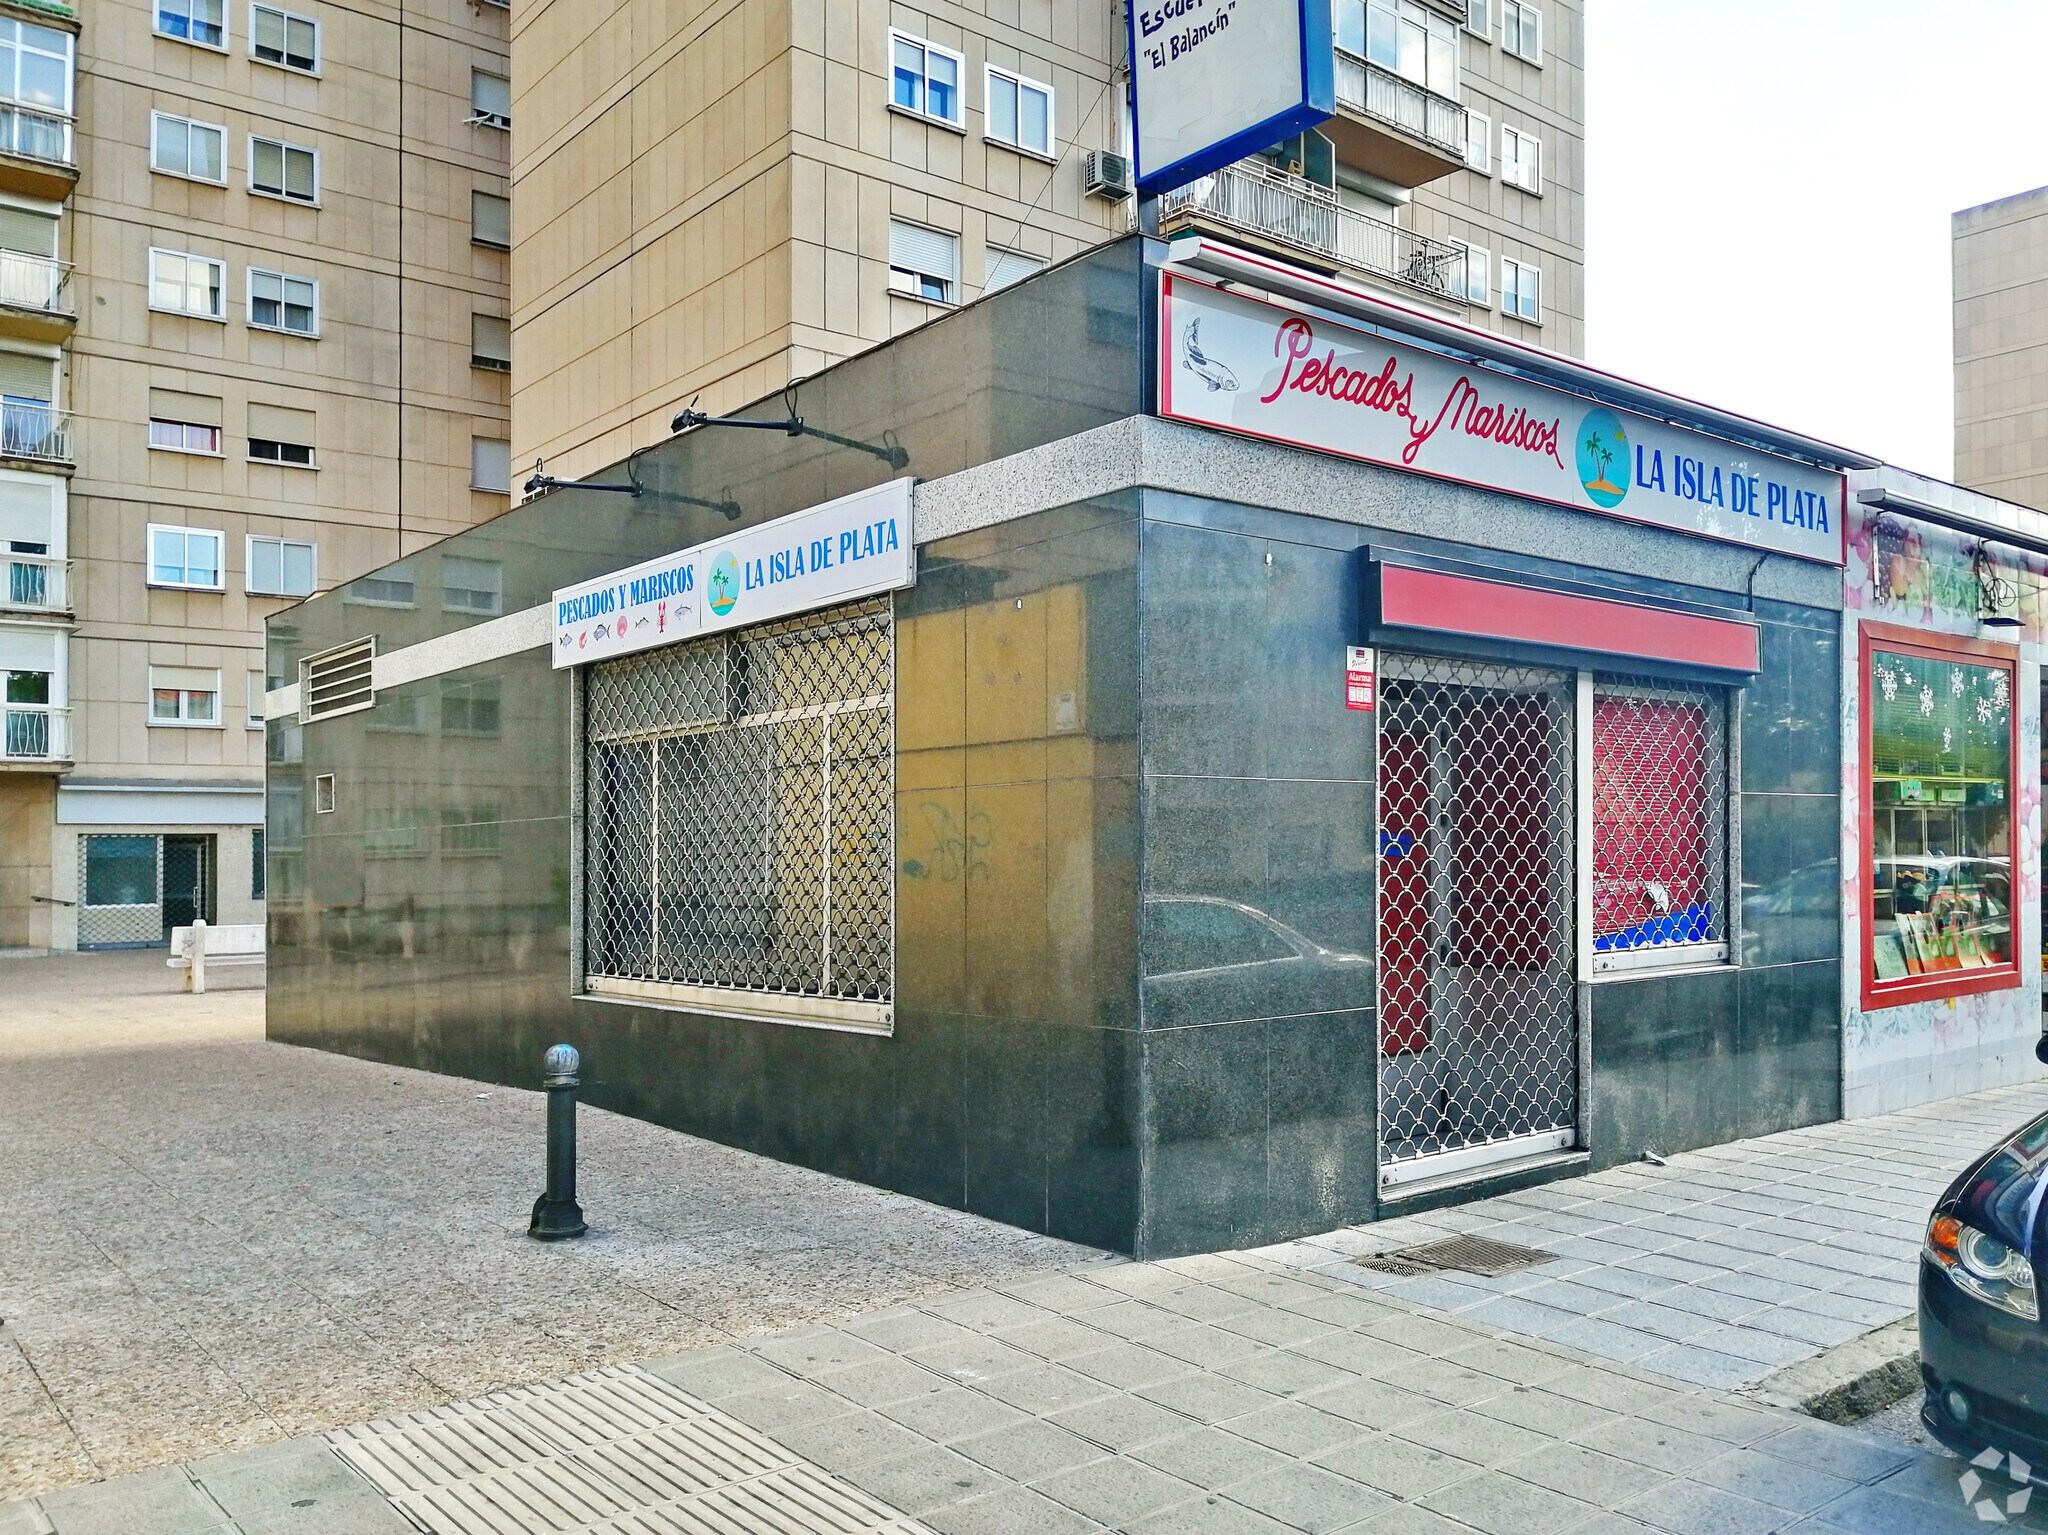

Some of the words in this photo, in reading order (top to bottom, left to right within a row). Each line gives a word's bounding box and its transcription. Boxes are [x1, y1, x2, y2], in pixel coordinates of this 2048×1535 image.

[1144, 42, 1166, 69] "El
[1170, 1, 1236, 61] Balancín"
[1260, 317, 1416, 418] Pescados
[1402, 414, 1434, 465] y
[1432, 376, 1564, 470] Mariscos
[1636, 444, 1666, 493] LA
[1674, 454, 1724, 508] ISLA
[1731, 472, 1760, 517] DE
[1767, 481, 1829, 534] PLATA
[745, 558, 765, 591] LA
[769, 546, 805, 584] ISLA
[811, 536, 834, 573] DE
[839, 518, 899, 565] PLATA
[558, 588, 615, 626] PESCADOS
[619, 583, 628, 607] Y
[630, 564, 694, 607] MARISCOS
[1348, 672, 1372, 682] Alarma
